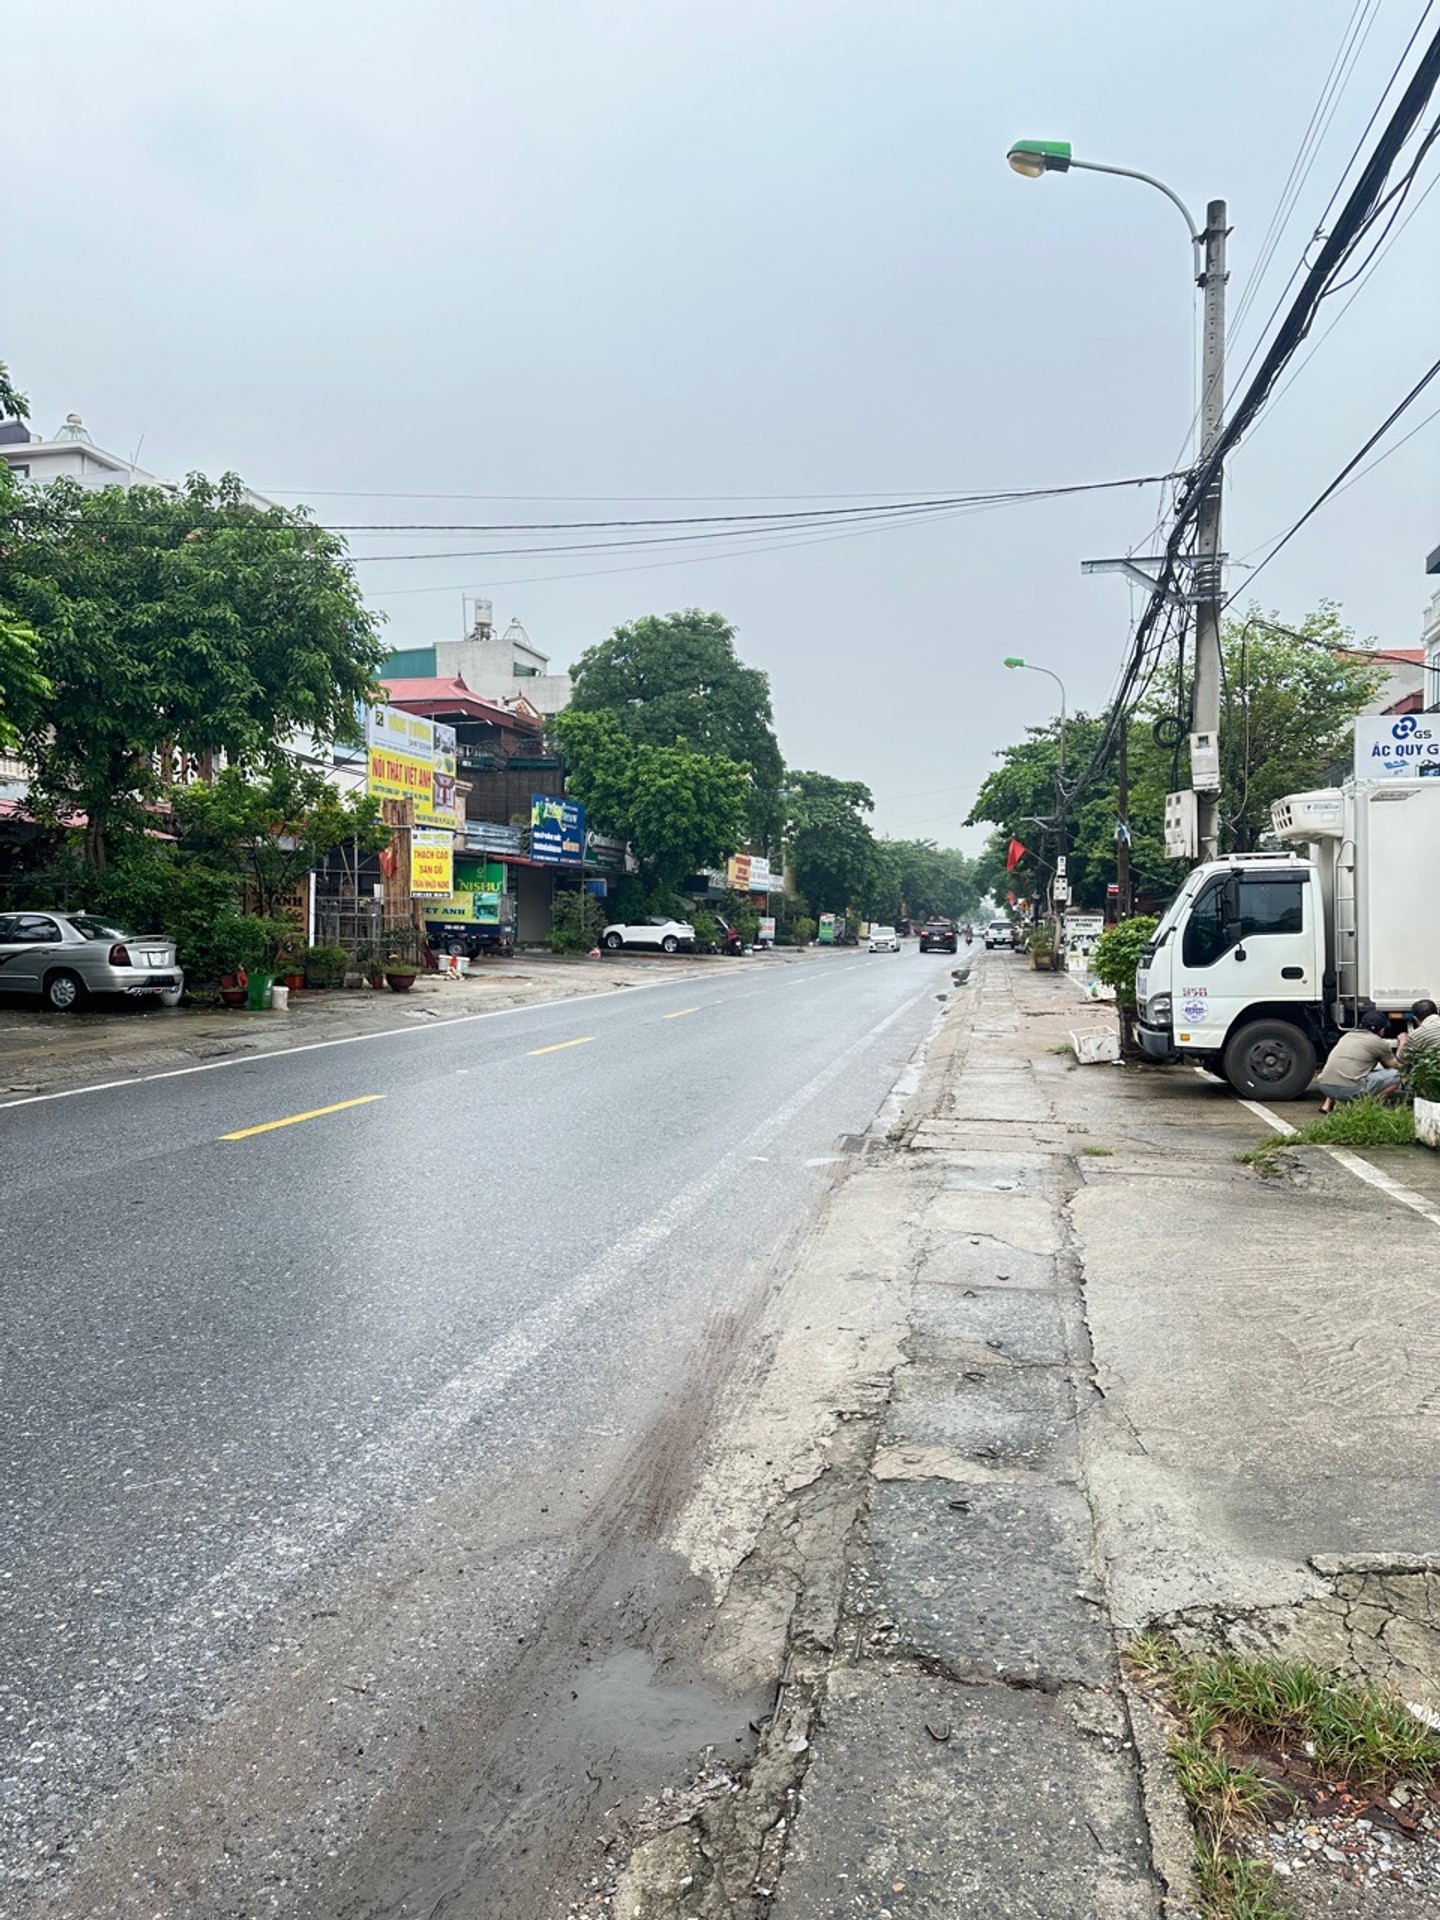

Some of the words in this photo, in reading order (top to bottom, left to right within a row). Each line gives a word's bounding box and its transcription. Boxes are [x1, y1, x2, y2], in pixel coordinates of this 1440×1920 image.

[1413, 729, 1433, 739] GS
[1395, 744, 1424, 757] QUY
[419, 769, 431, 788] ANH
[435, 850, 449, 860] CAO
[442, 907, 465, 915] ANH
